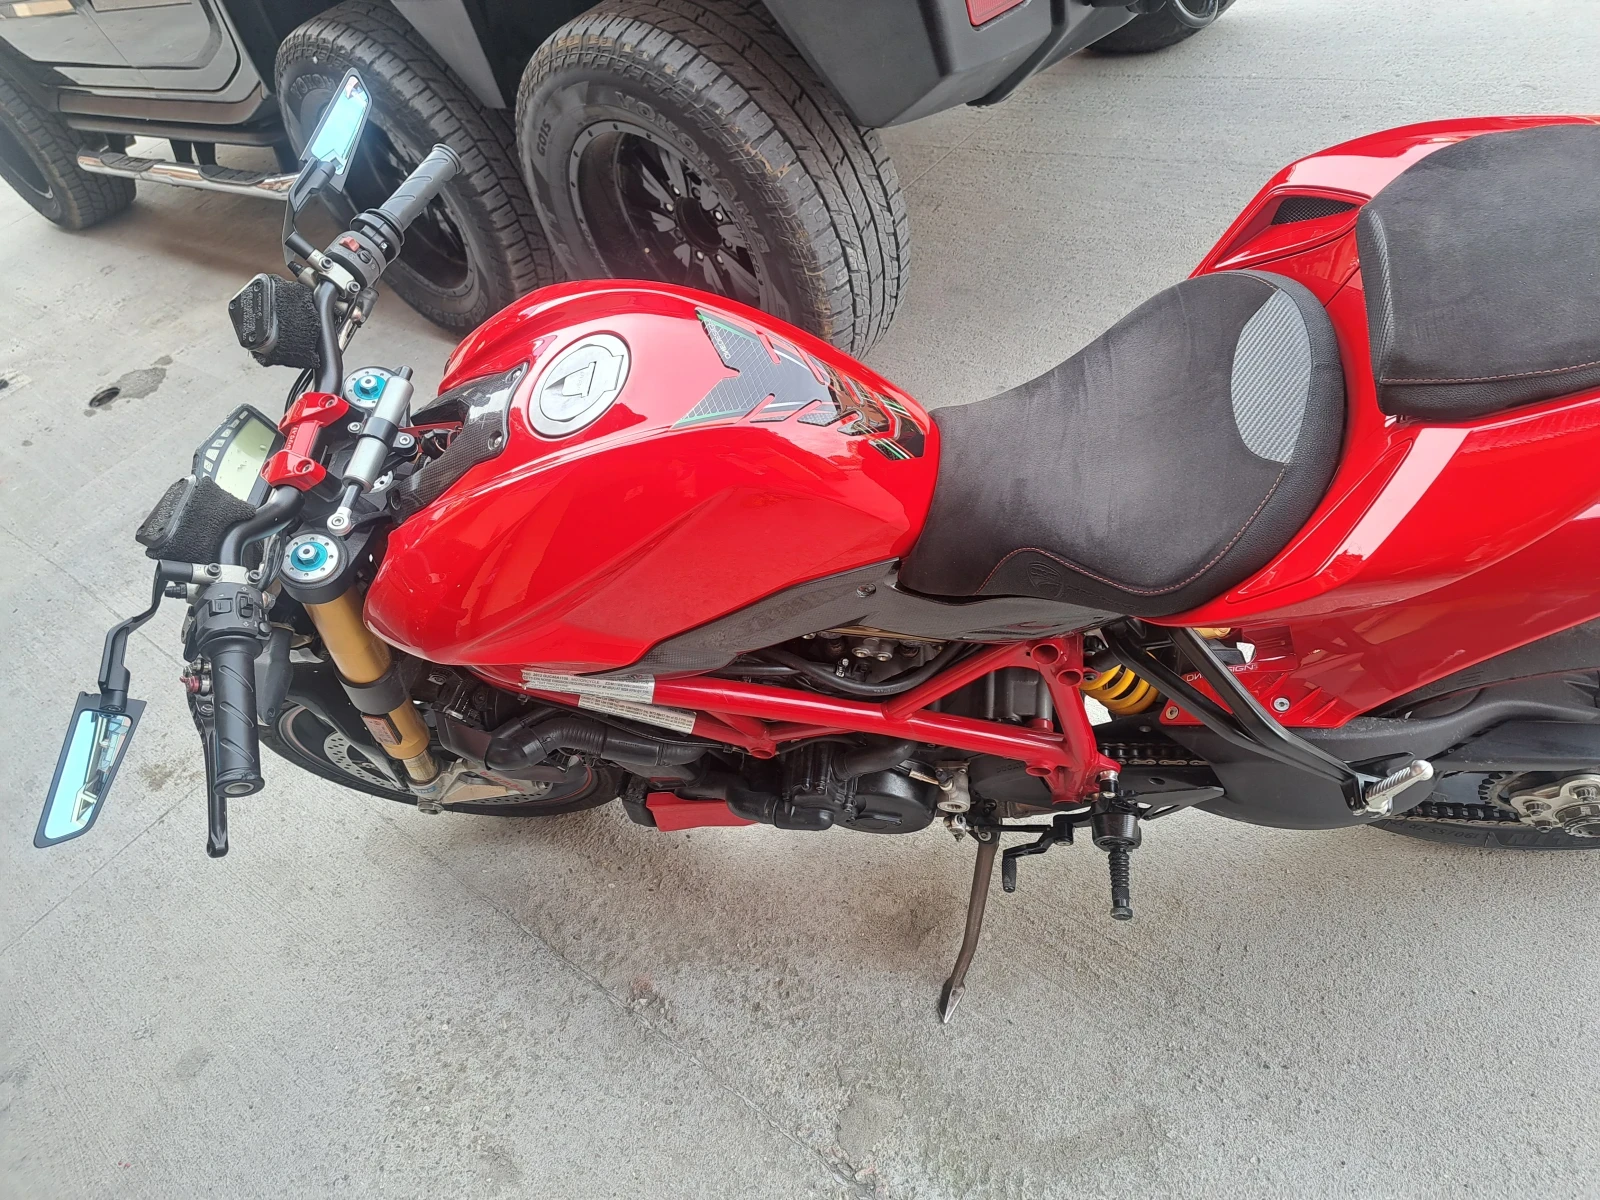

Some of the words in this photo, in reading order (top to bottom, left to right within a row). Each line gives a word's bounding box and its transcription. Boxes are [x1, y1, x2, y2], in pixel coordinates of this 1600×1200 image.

[536, 118, 553, 158] G015
[614, 90, 771, 254] YOKOHAMA
[1428, 826, 1480, 840] 190/55
